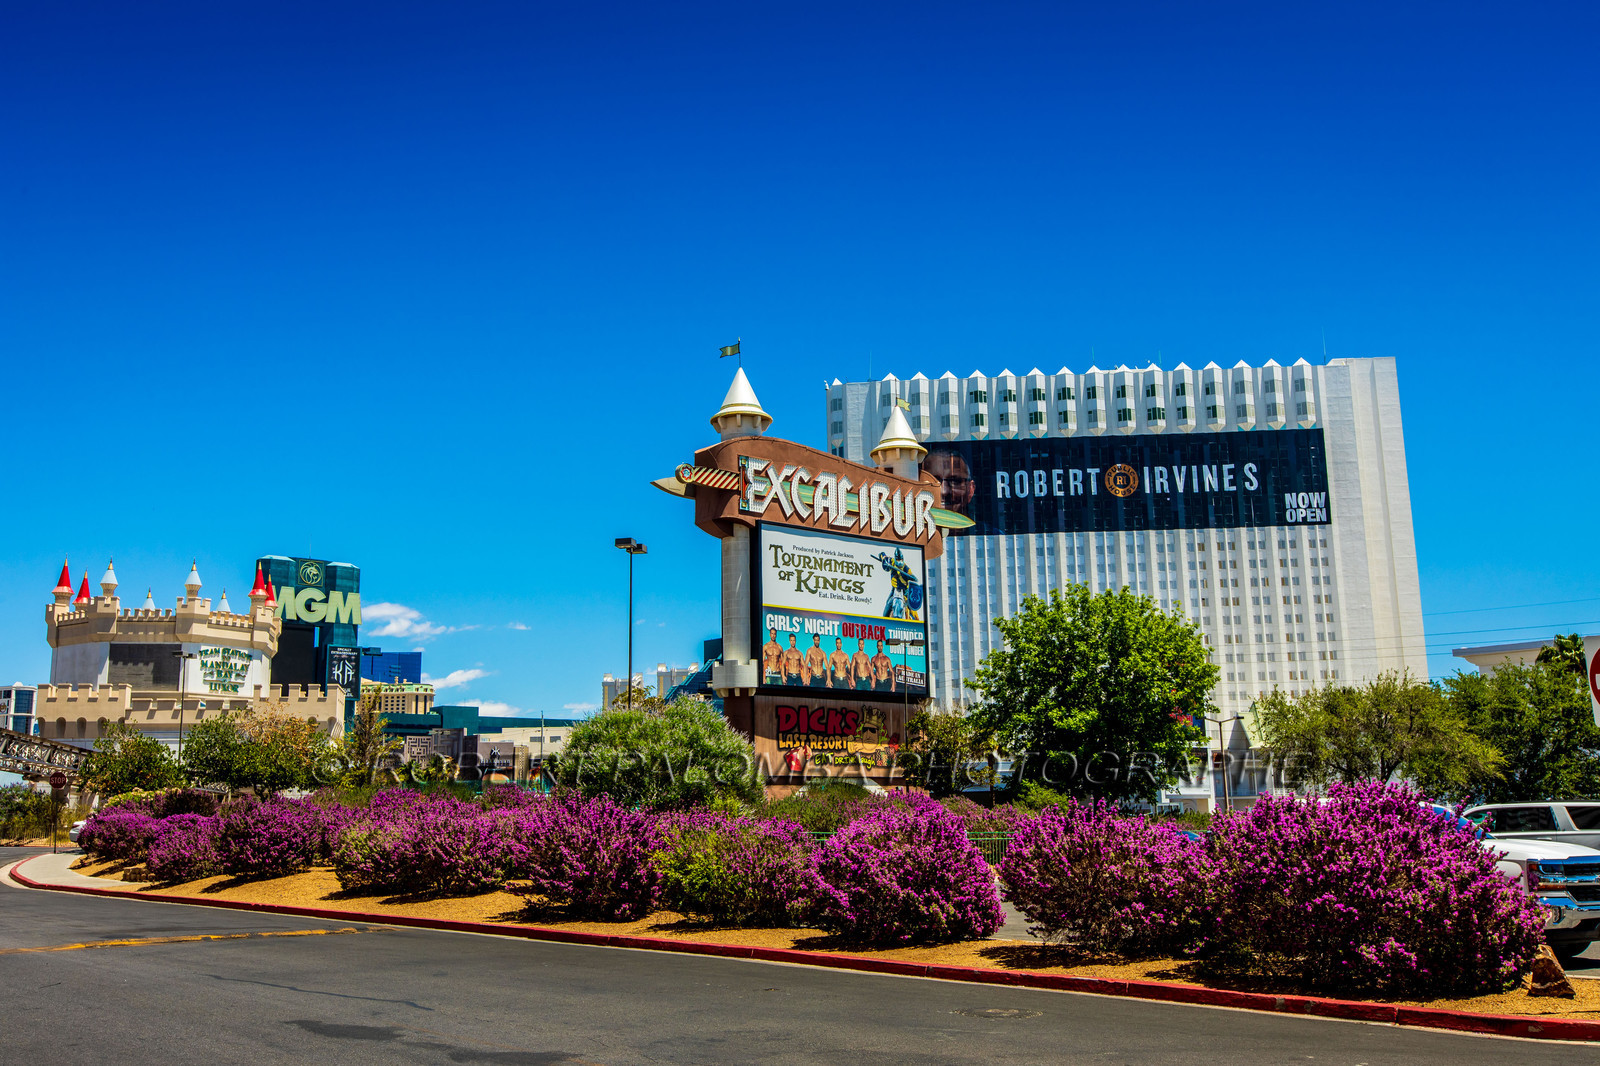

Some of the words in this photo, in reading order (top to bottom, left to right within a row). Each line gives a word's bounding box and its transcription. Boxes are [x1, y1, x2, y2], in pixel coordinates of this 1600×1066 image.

[1107, 465, 1135, 477] PUBLIC
[996, 467, 1100, 499] ROBERT
[1108, 484, 1136, 496] HOUSE
[747, 456, 937, 539] EXCALIBUR
[1284, 492, 1326, 509] NOW
[1286, 508, 1327, 522] OPEN
[792, 544, 814, 553] Produced
[815, 547, 820, 555] by
[821, 548, 837, 556] Patrick
[837, 551, 854, 559] Jackson
[769, 544, 875, 577] TOURNAMENT
[794, 568, 865, 594] KINGS
[267, 585, 362, 625] MGM
[818, 591, 829, 599] Eat.
[830, 593, 846, 601] Drink.
[847, 594, 854, 602] Be
[854, 595, 872, 605] Rowdy!
[804, 618, 840, 637] NIGHT
[842, 621, 886, 641] OUTBACK
[221, 647, 253, 661] STATION
[200, 660, 250, 672] MANDALAY
[216, 670, 233, 679] BAY
[209, 682, 239, 693] LUXOR
[777, 705, 859, 736] DICK'S
[778, 733, 806, 749] LAST
[808, 734, 850, 750] RESORT
[815, 752, 834, 765] EAT
[834, 755, 857, 765] DRINK
[50, 776, 66, 784] STOP
